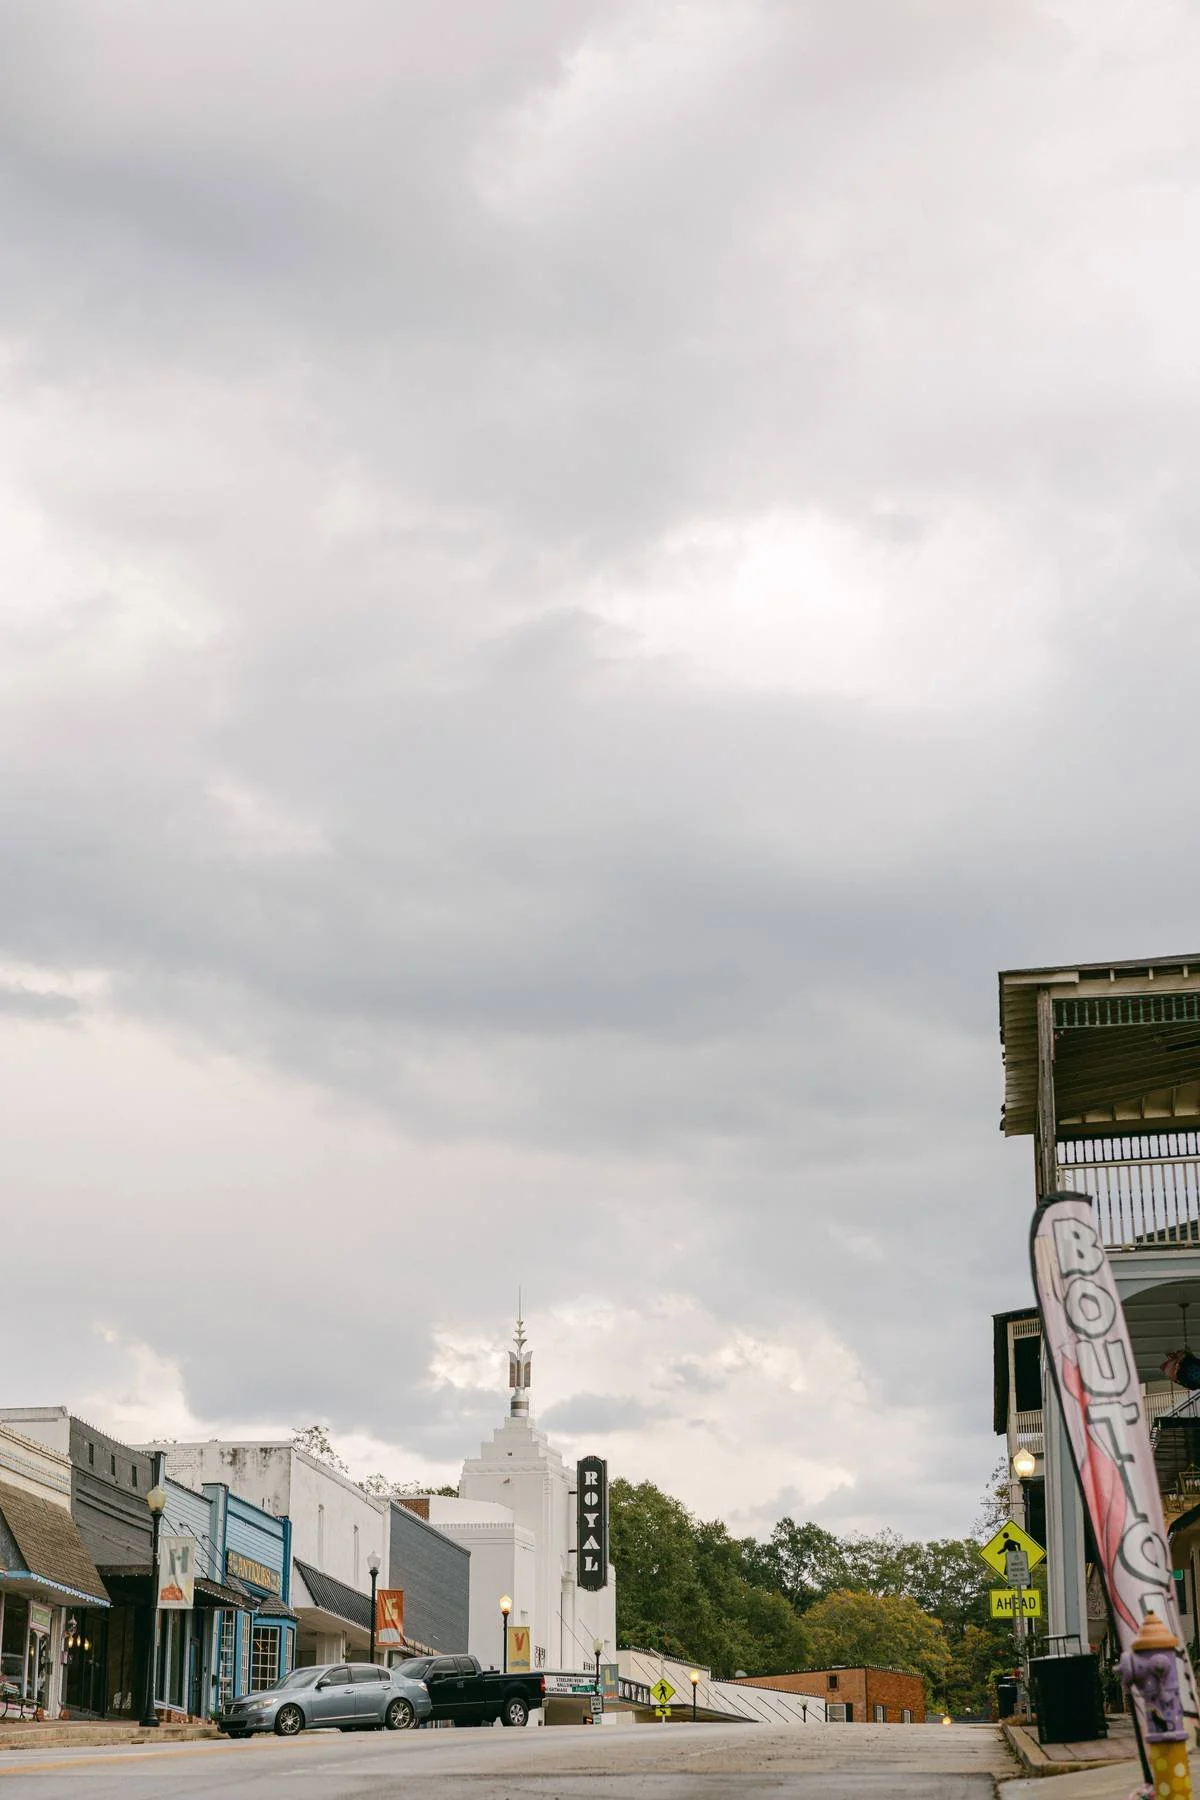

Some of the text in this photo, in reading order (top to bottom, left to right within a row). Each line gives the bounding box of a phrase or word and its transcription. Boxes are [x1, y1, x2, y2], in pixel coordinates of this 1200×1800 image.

[1052, 1217, 1184, 1650] BOUTIQ
[582, 1471, 601, 1571] ROYAL
[239, 1558, 270, 1587] ANTIQUES
[996, 1596, 1036, 1610] AHEAD
[512, 1632, 525, 1651] V
[605, 1669, 615, 1685] L
[618, 1681, 649, 1705] ROYAL
